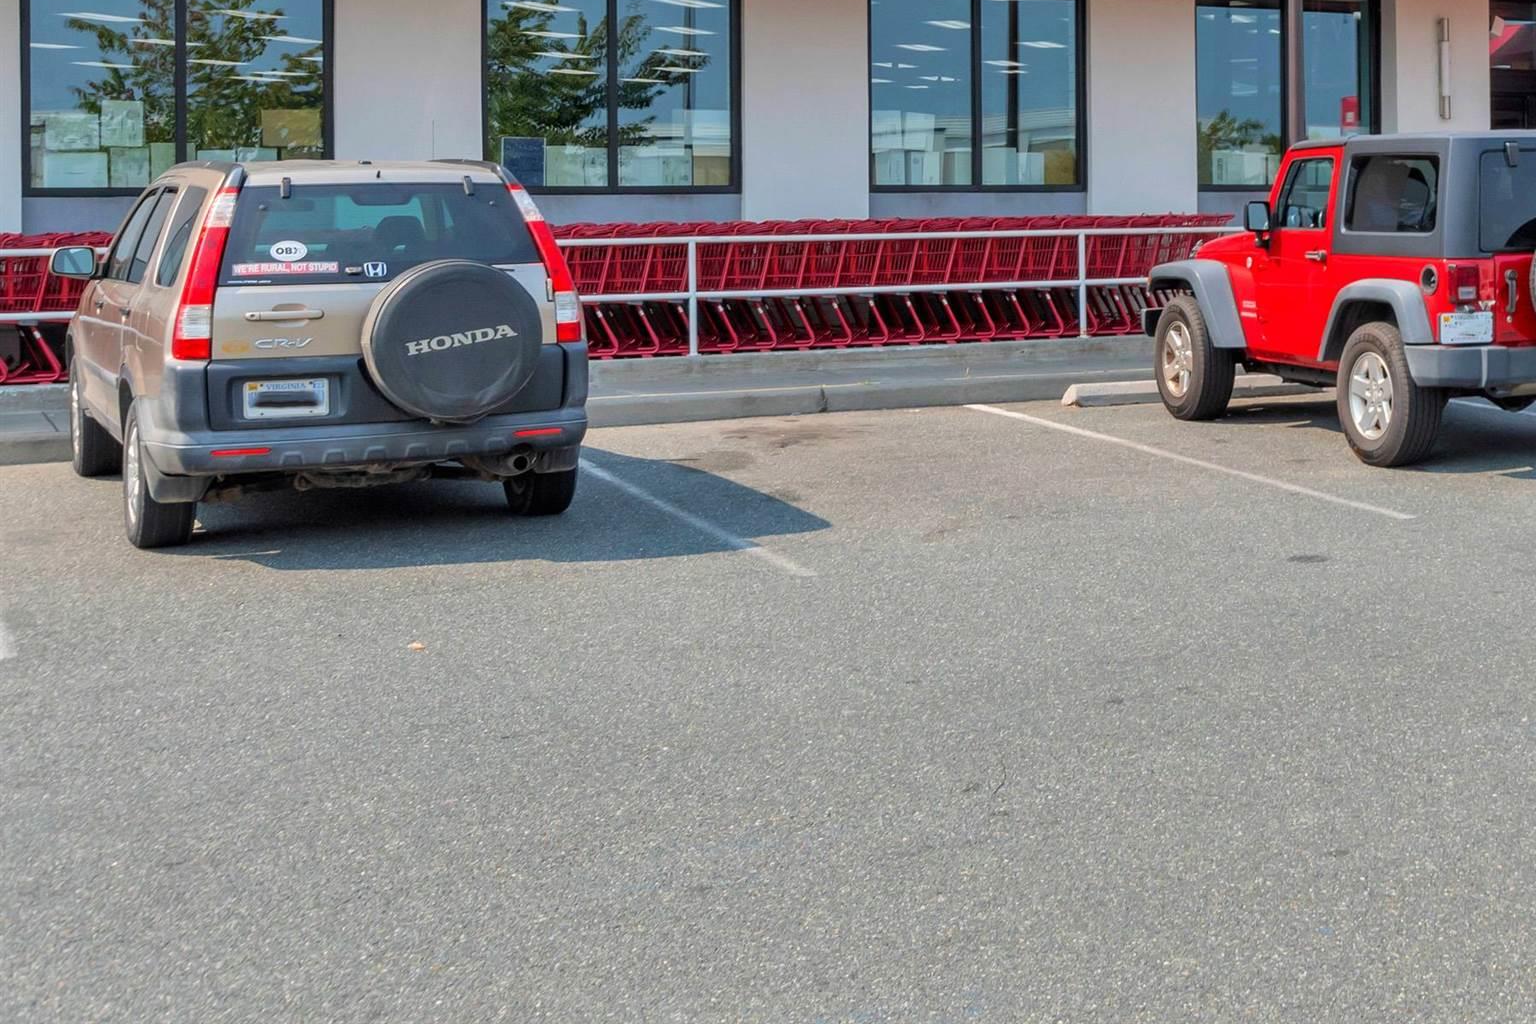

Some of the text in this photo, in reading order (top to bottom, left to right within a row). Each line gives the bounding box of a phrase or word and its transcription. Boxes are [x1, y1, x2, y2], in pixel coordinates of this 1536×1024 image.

[233, 263, 260, 274] WE'RE
[290, 262, 308, 272] NOT
[308, 261, 337, 272] STUPID
[255, 337, 313, 349] CR-V
[405, 324, 518, 356] HONDA
